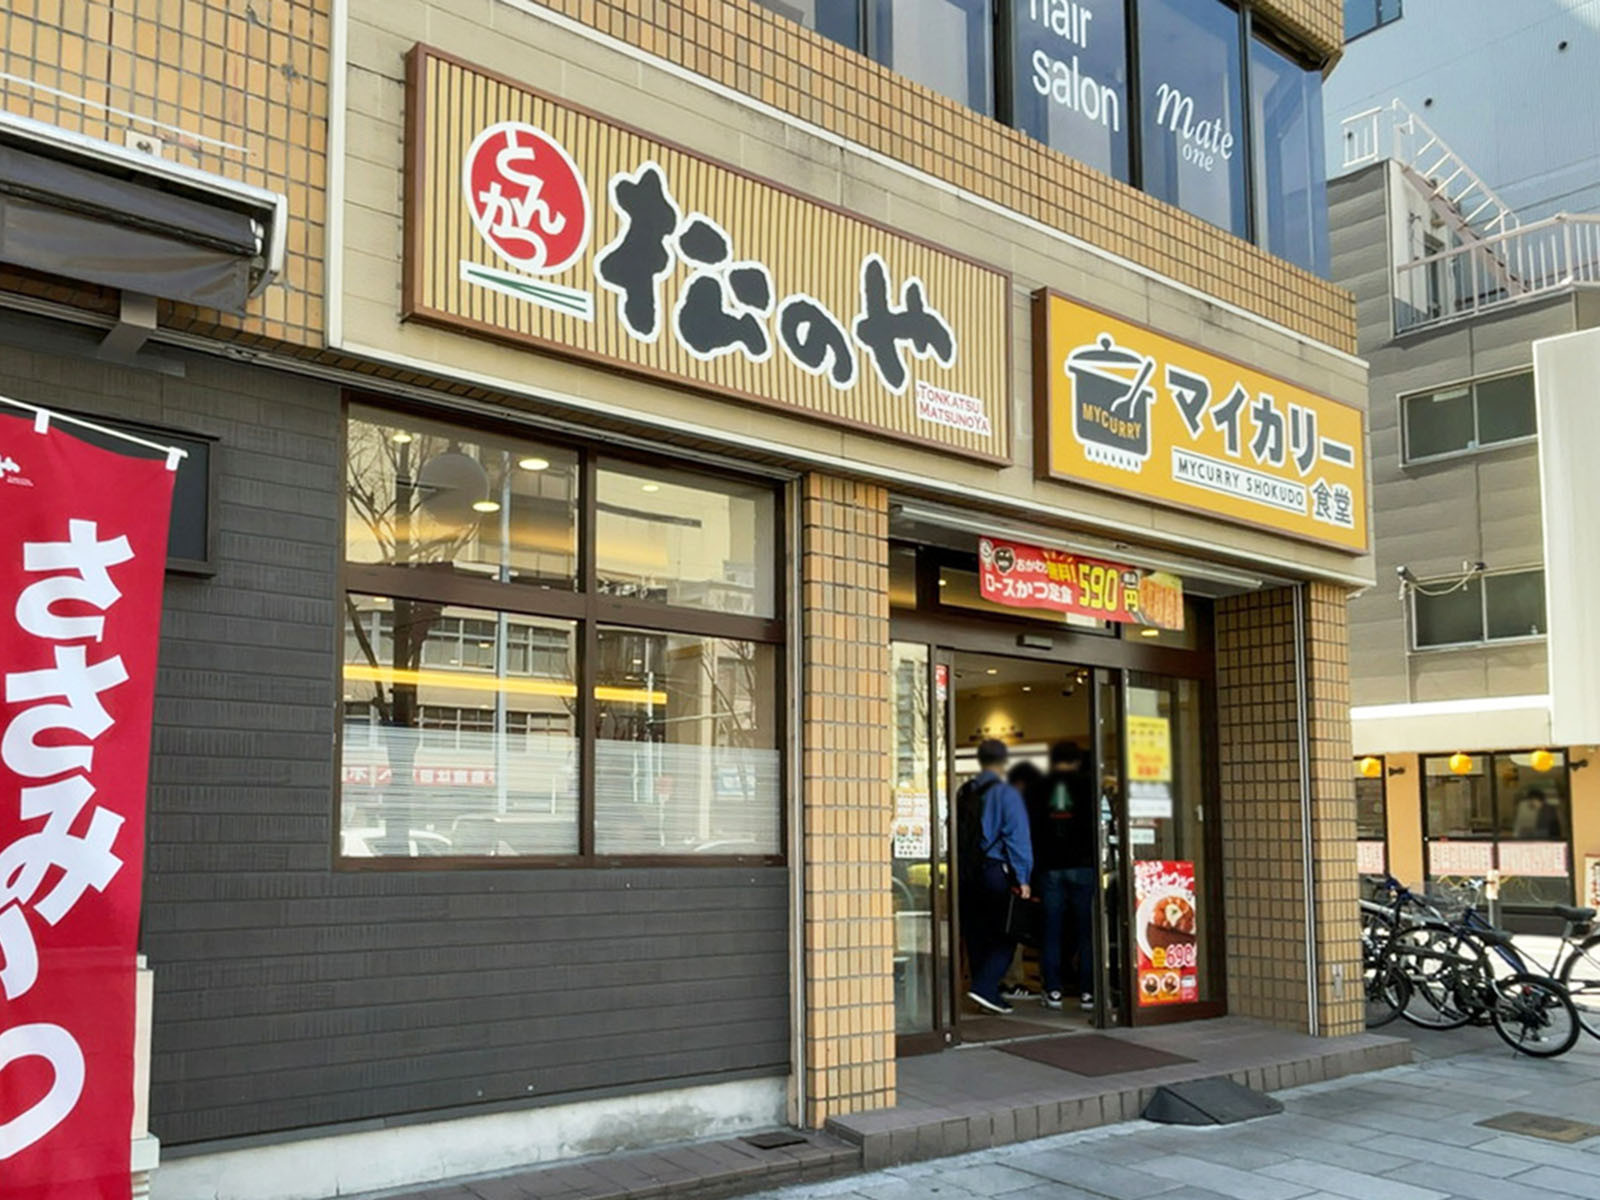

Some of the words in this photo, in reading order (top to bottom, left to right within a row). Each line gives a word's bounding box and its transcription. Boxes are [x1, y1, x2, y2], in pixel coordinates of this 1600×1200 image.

[1032, 50, 1119, 132] salon
[1156, 83, 1234, 159] Mate
[1182, 143, 1214, 172] one
[595, 162, 957, 396] 松のや
[918, 383, 981, 414] TONKATSU
[919, 401, 990, 433] MATSUNOYA
[1082, 402, 1142, 438] MYCURRY
[1165, 364, 1354, 476] マイカリー
[1177, 461, 1240, 490] MYCURRY
[1246, 477, 1305, 507] SHOKUDO
[1311, 479, 1354, 528] 食堂
